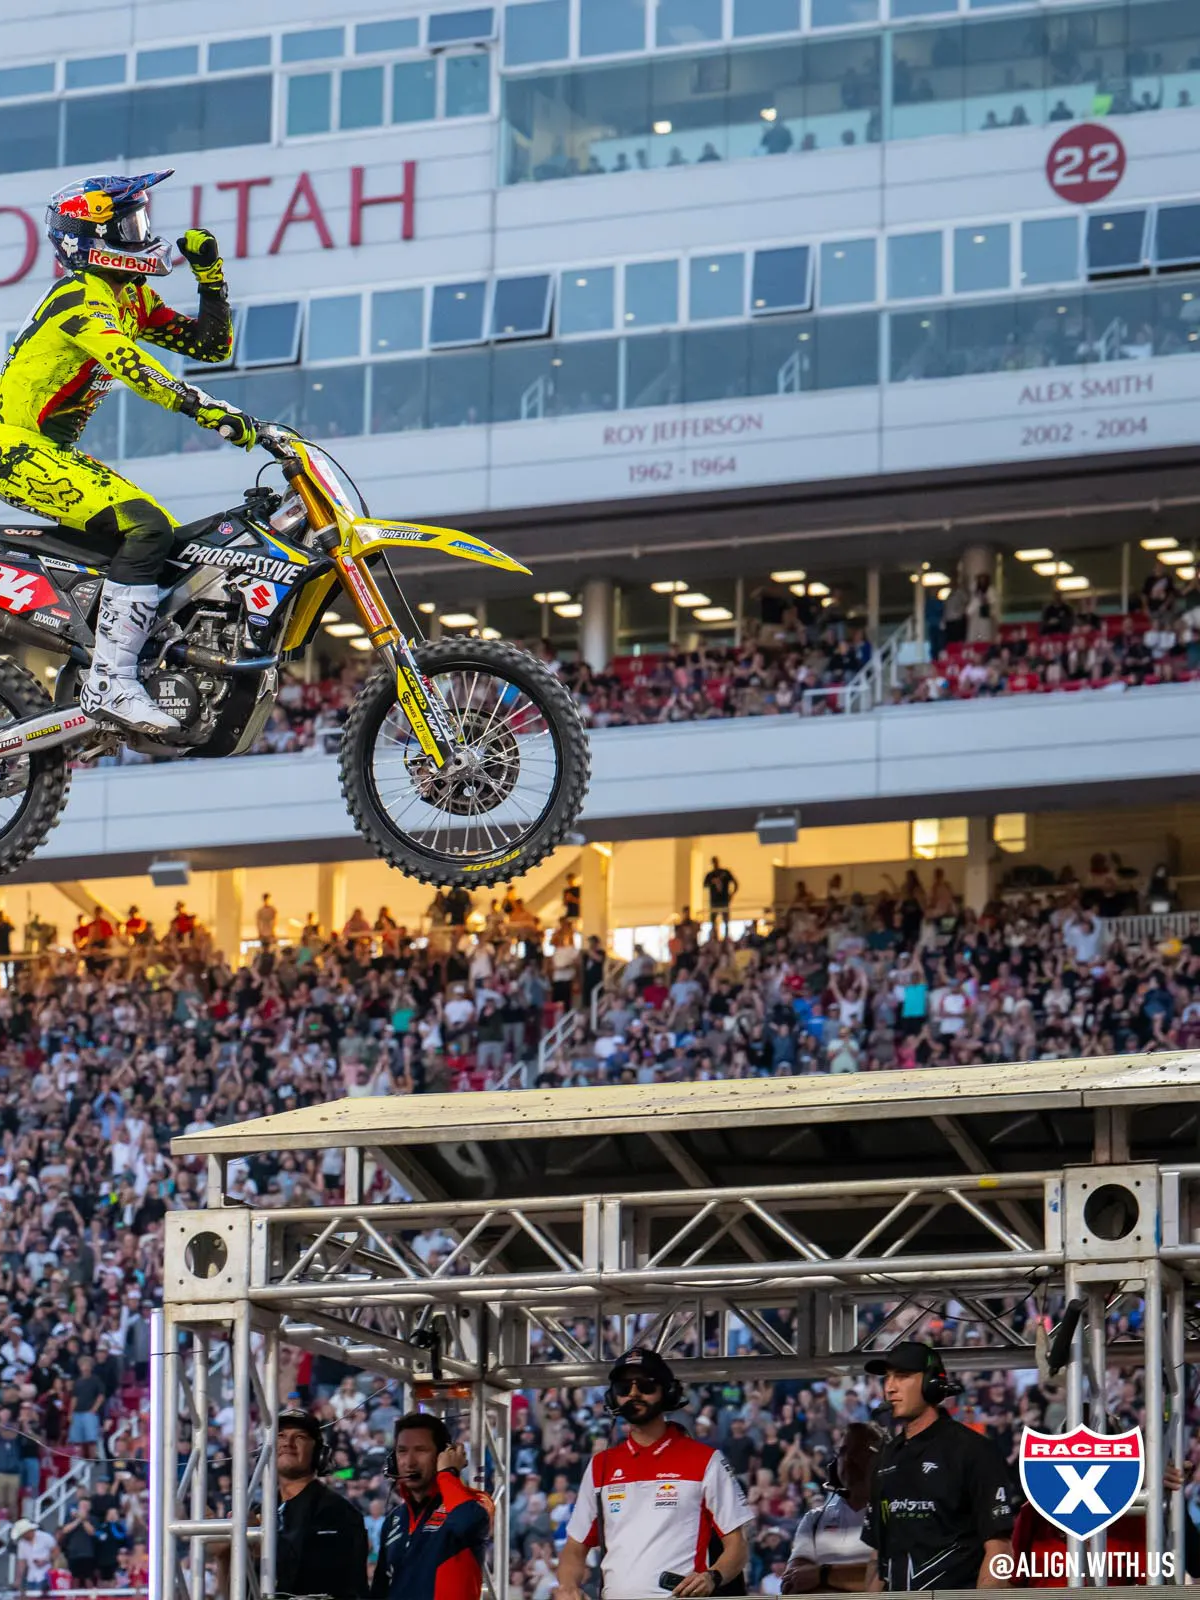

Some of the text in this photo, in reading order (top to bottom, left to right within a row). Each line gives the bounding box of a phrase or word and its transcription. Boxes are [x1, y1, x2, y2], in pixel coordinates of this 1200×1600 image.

[1052, 141, 1119, 187] 22
[89, 249, 157, 273] Red Bull
[1018, 374, 1154, 405] ALEX SMITH
[603, 413, 764, 446] ROY JEFFERSON
[1021, 424, 1075, 446] 2002
[1096, 416, 1148, 439] 2004
[628, 461, 673, 484] 1962
[692, 456, 737, 478] 1964
[376, 528, 424, 541] OGRESSIVE
[44, 558, 71, 569] SUZUKI
[177, 542, 303, 585] PROGRESSIVE
[100, 607, 119, 625] FOX
[158, 681, 176, 697] H
[155, 698, 190, 707] UZUKI
[26, 724, 61, 741] HINSON
[462, 848, 521, 873] DUNLOP
[995, 1486, 1006, 1502] 4
